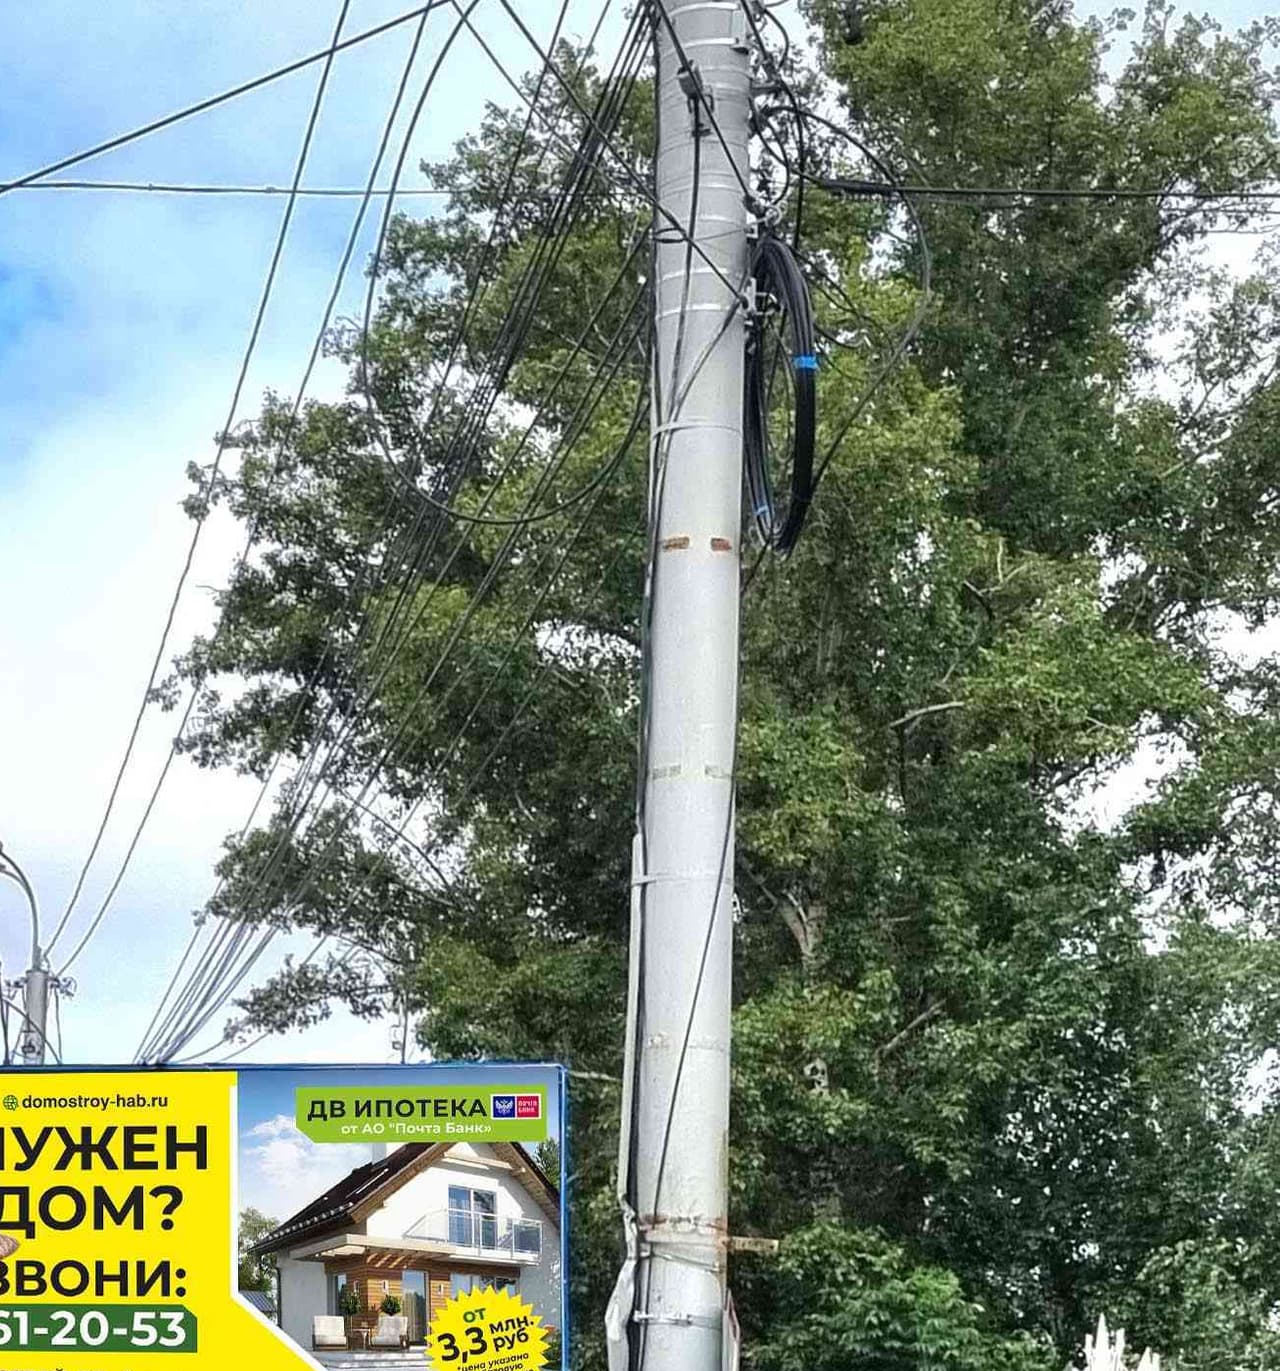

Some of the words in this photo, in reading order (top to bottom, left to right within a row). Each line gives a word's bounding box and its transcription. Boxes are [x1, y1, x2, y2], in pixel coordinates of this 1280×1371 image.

[22, 1094, 168, 1111] domostroy-hab.ru
[307, 1100, 345, 1121] ДВ
[354, 1098, 487, 1118] ИПОТЕКА
[341, 1125, 358, 1135] от
[362, 1123, 385, 1135] АО
[437, 1326, 488, 1363] 3,3
[489, 1316, 534, 1334] млн.
[493, 1327, 529, 1352] руб
[488, 1352, 529, 1368] указано
